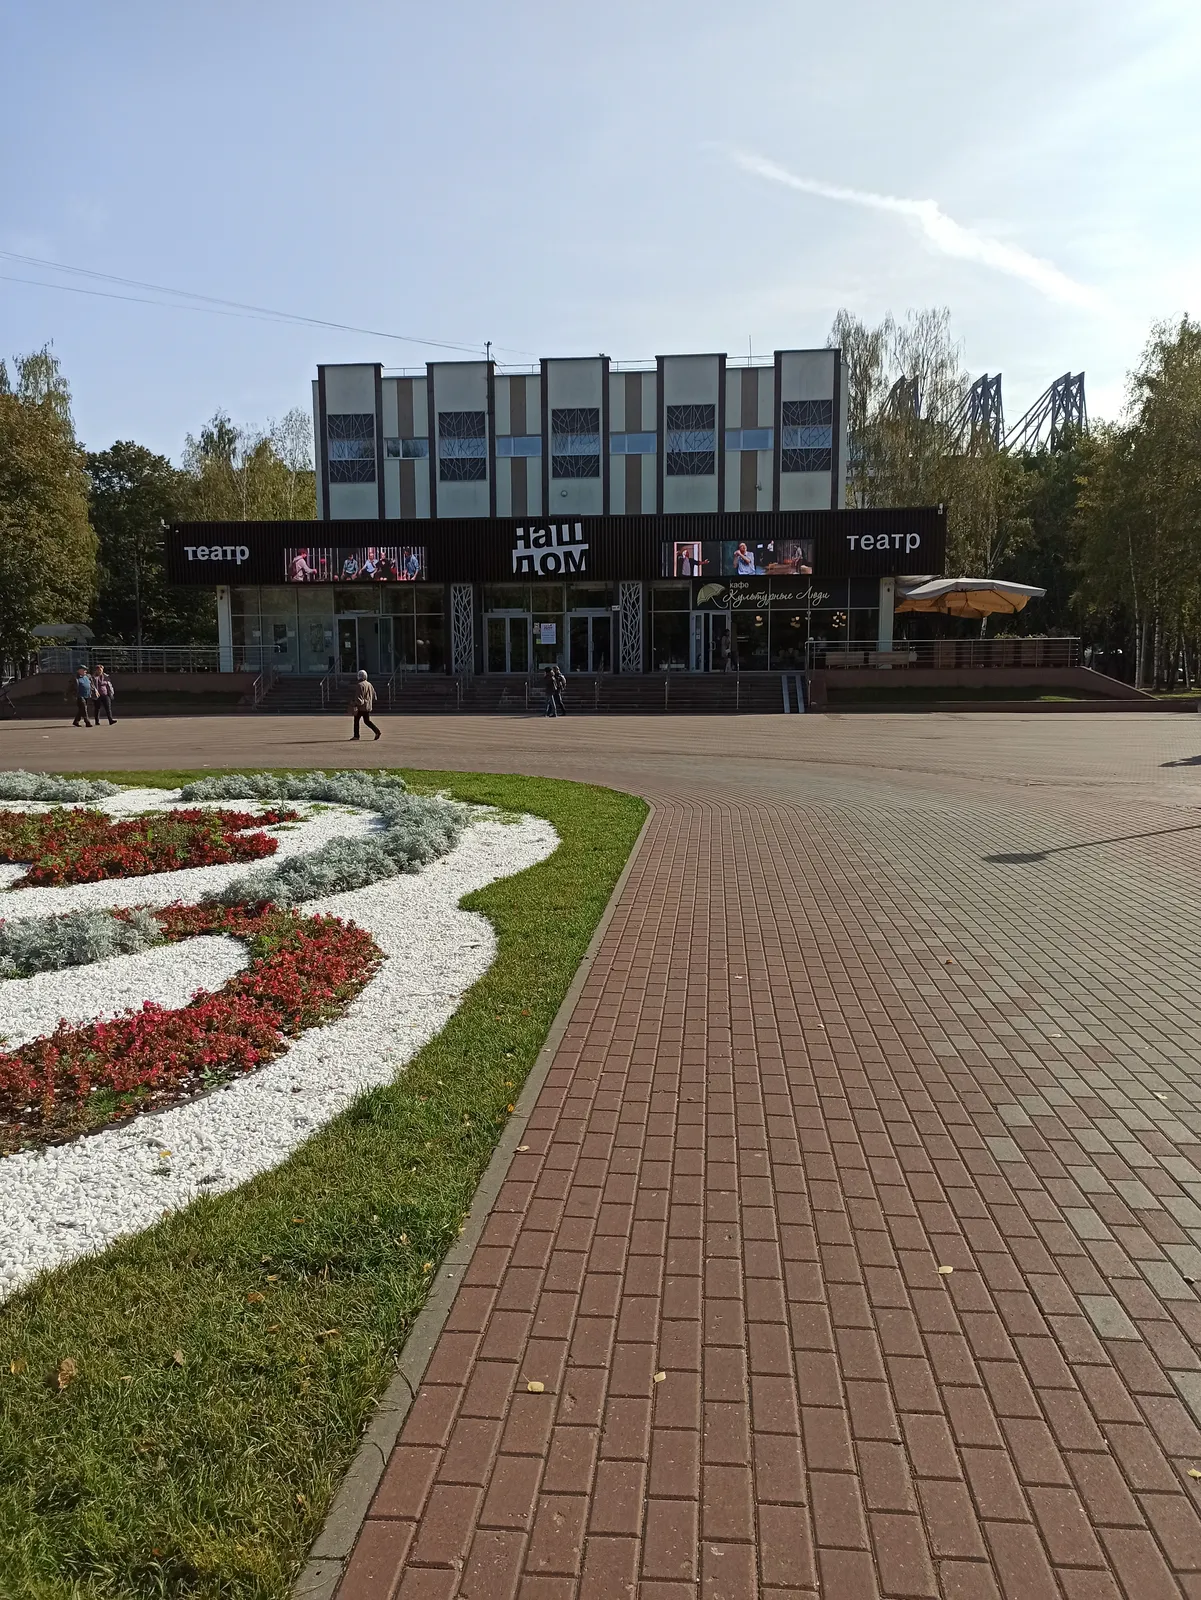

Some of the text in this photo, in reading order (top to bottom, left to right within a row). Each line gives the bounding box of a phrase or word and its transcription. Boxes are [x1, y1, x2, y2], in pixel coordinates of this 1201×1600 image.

[846, 532, 921, 554] театр
[183, 545, 250, 565] театр
[729, 581, 749, 589] кафе
[722, 585, 830, 608] Культурные Люди
